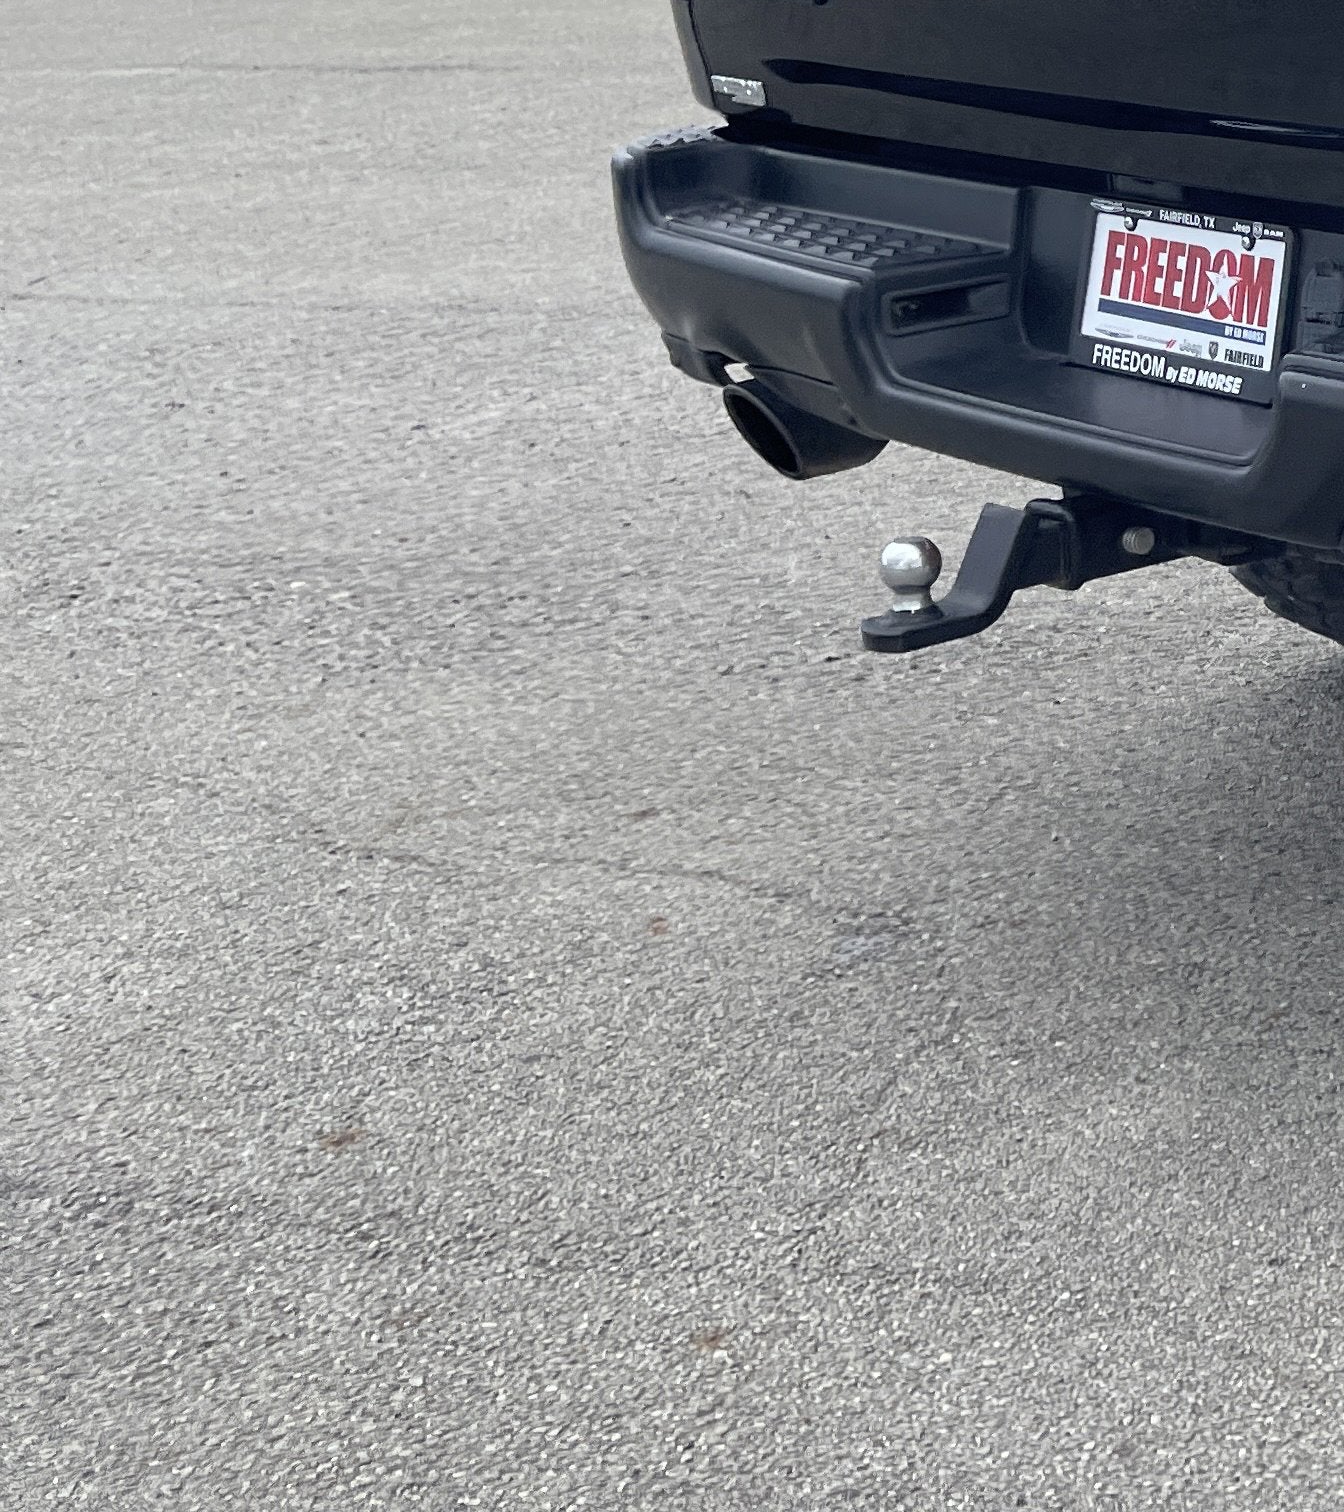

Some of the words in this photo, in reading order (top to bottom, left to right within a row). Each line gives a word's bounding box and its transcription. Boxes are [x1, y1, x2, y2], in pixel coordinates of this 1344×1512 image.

[1159, 209, 1202, 227] FAIRFIELD,
[1203, 215, 1216, 229] TX
[1100, 230, 1275, 327] FREEDOM
[1092, 343, 1166, 378] FREEDOM
[1178, 366, 1197, 385] ED
[1196, 369, 1243, 395] MORSE
[1223, 348, 1265, 368] FAIRFIELD
